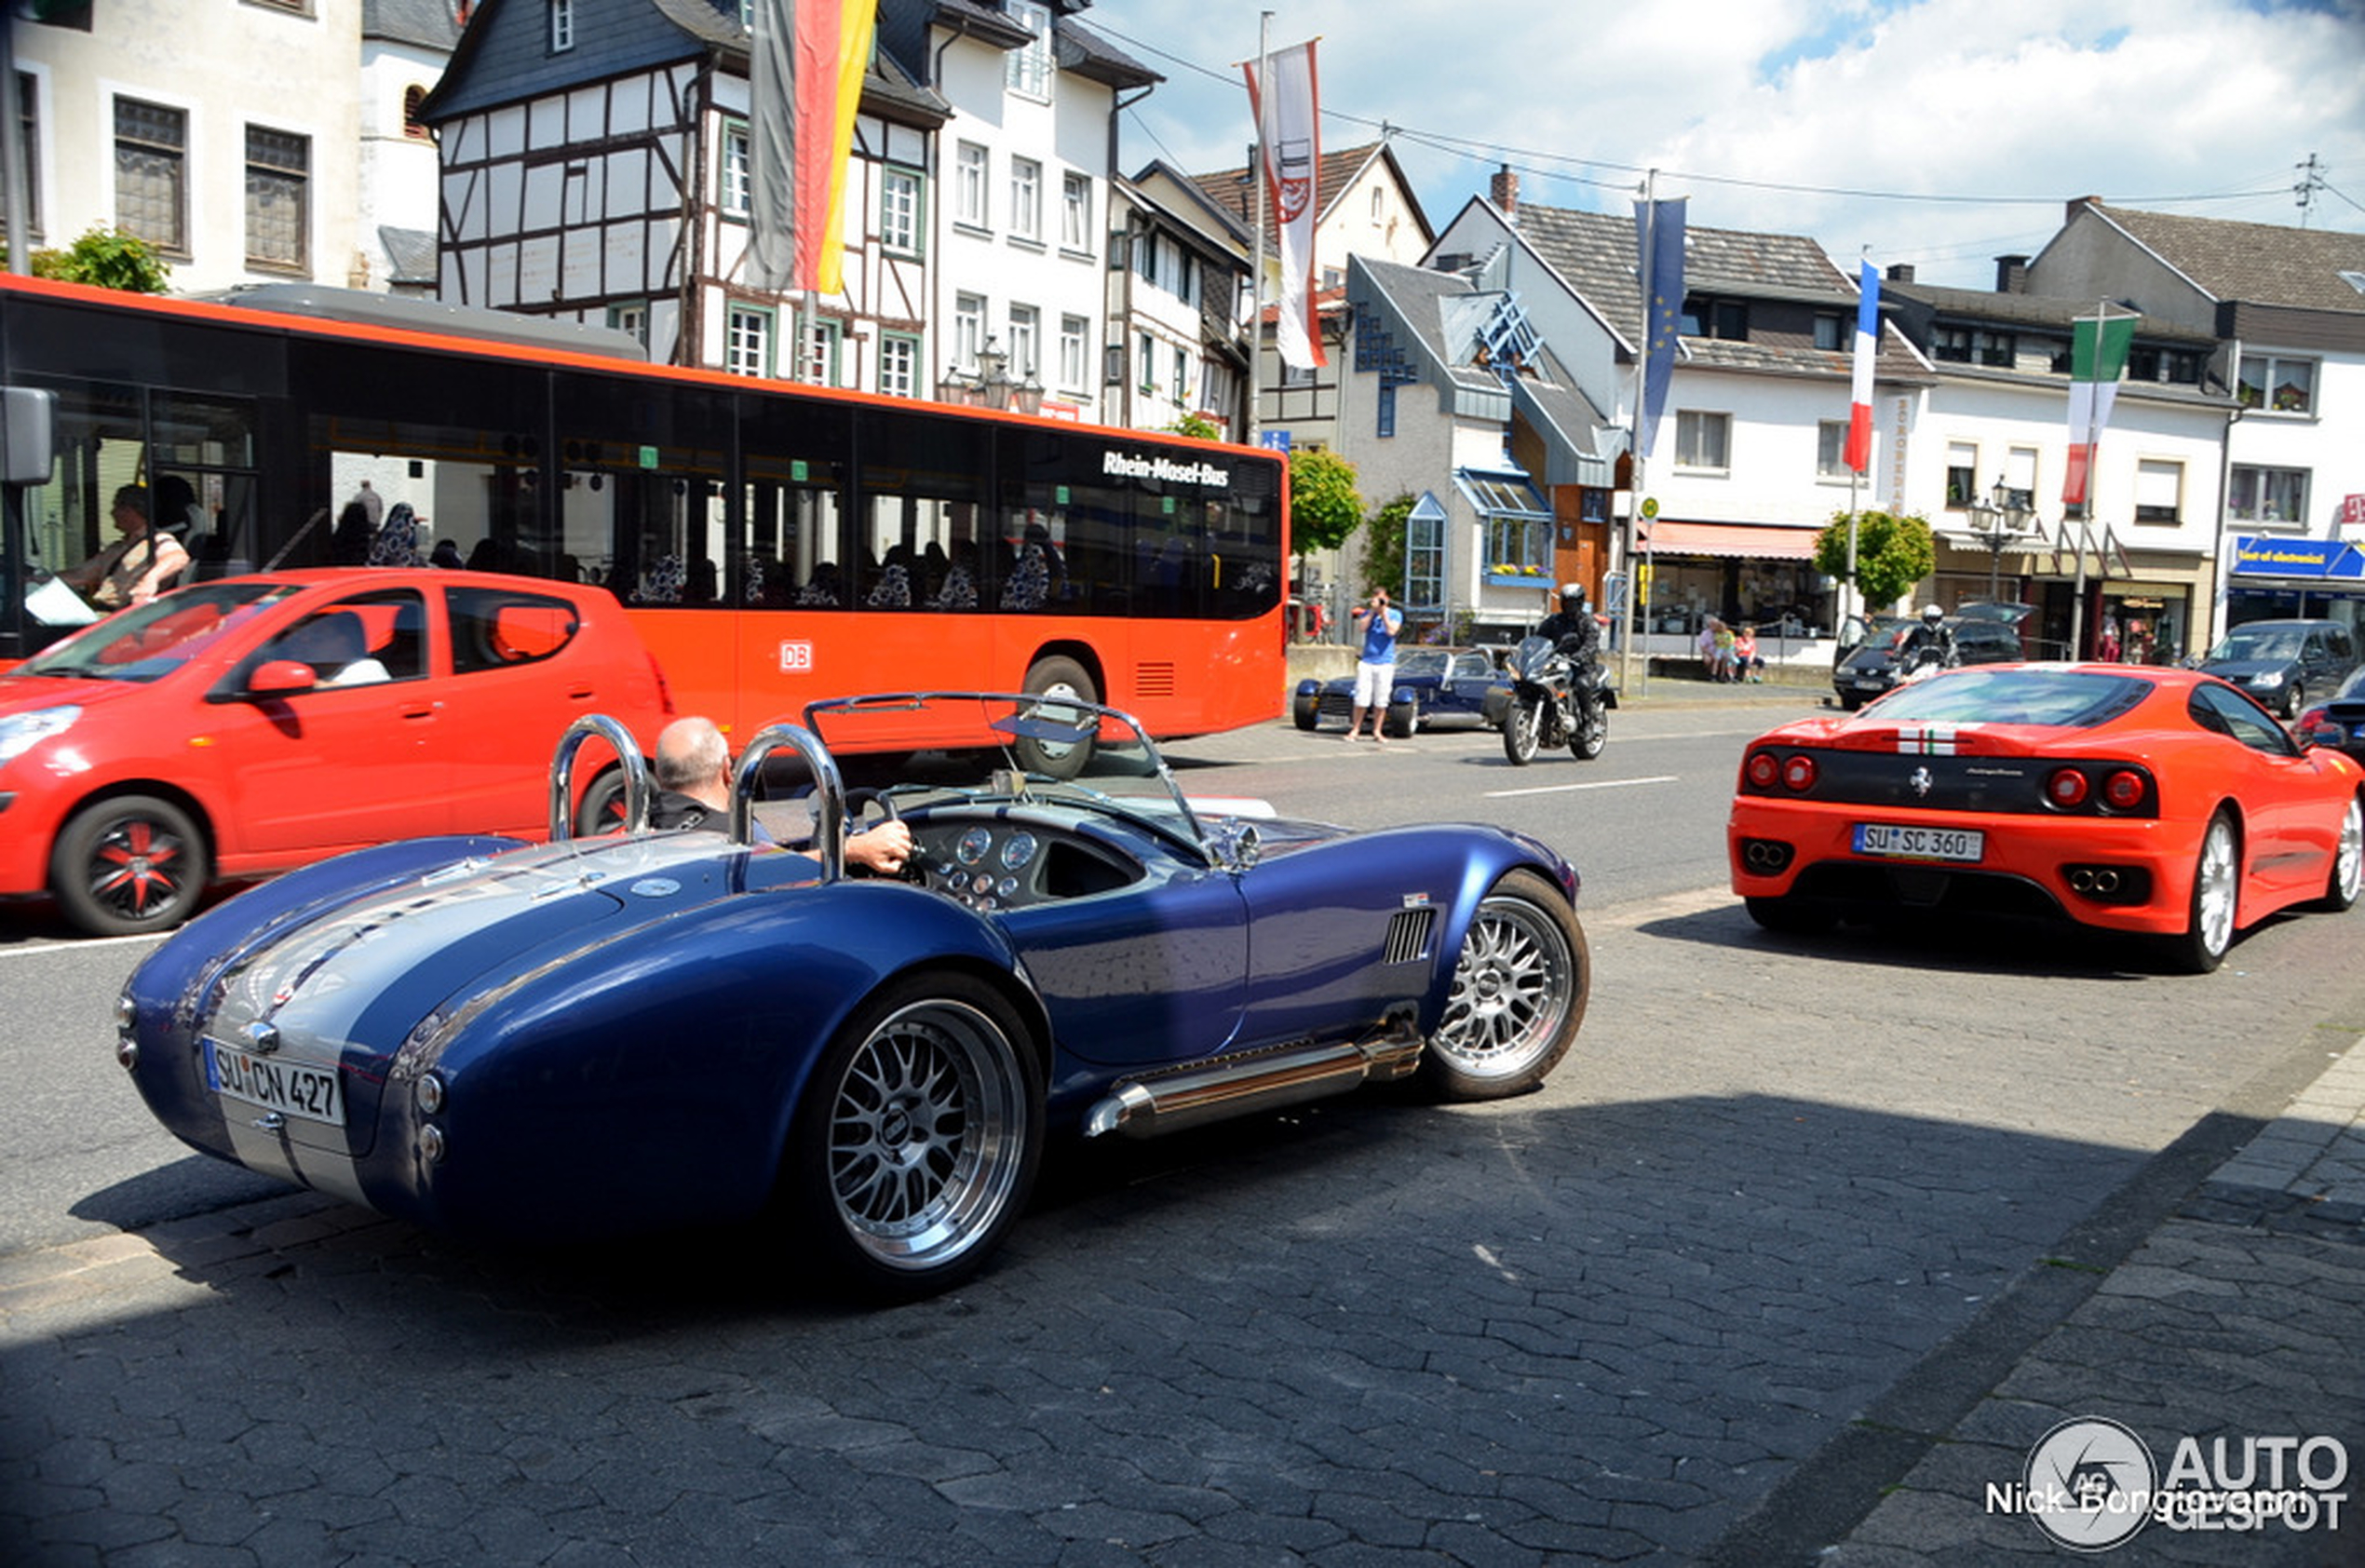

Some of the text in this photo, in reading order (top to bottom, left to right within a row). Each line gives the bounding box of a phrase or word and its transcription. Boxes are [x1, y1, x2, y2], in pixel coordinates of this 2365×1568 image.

[1103, 451, 1229, 487] Rhein-Mosel-Bus
[785, 646, 807, 666] DB
[1866, 828, 1888, 849] SU
[1902, 830, 1926, 852] SC
[1930, 831, 1967, 855] 360
[216, 1048, 333, 1116] SU CN 427
